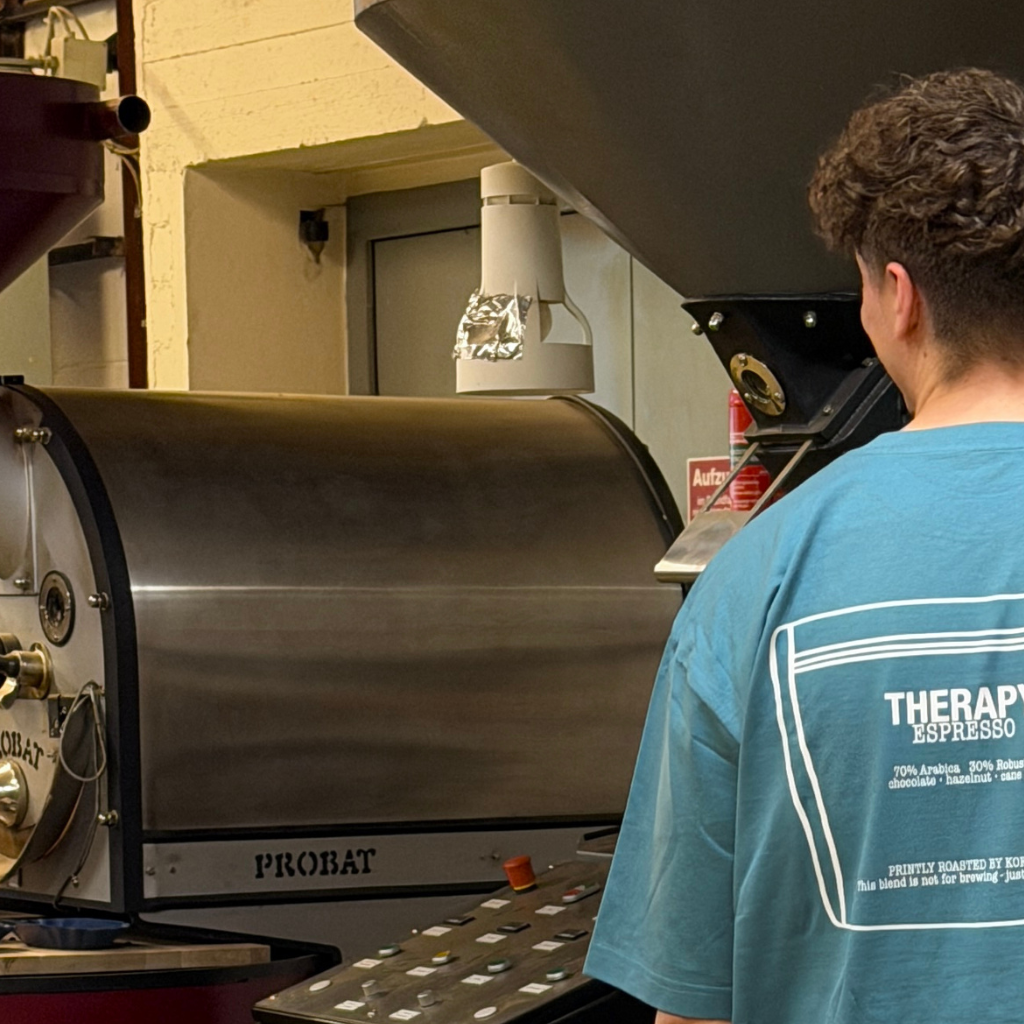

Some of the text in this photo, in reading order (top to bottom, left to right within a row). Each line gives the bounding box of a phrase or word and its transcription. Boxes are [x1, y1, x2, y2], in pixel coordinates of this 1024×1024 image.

[912, 718, 1016, 744] ESPRESSO
[0, 730, 44, 771] OBAT
[888, 775, 937, 789] chocolate
[945, 773, 993, 785] hazelnut
[1000, 770, 1022, 781] cane
[893, 765, 918, 778] 70%
[919, 763, 961, 776] Arabica
[969, 760, 994, 772] 30%
[255, 848, 376, 879] PROBAT
[888, 861, 935, 877] PRINTLY
[938, 859, 987, 873] ROASTED
[988, 857, 1003, 869] BY
[857, 879, 876, 892] This
[879, 876, 907, 890] blend
[909, 876, 919, 888] is
[921, 874, 939, 887] not
[941, 872, 957, 885] for
[959, 870, 999, 884] brewing
